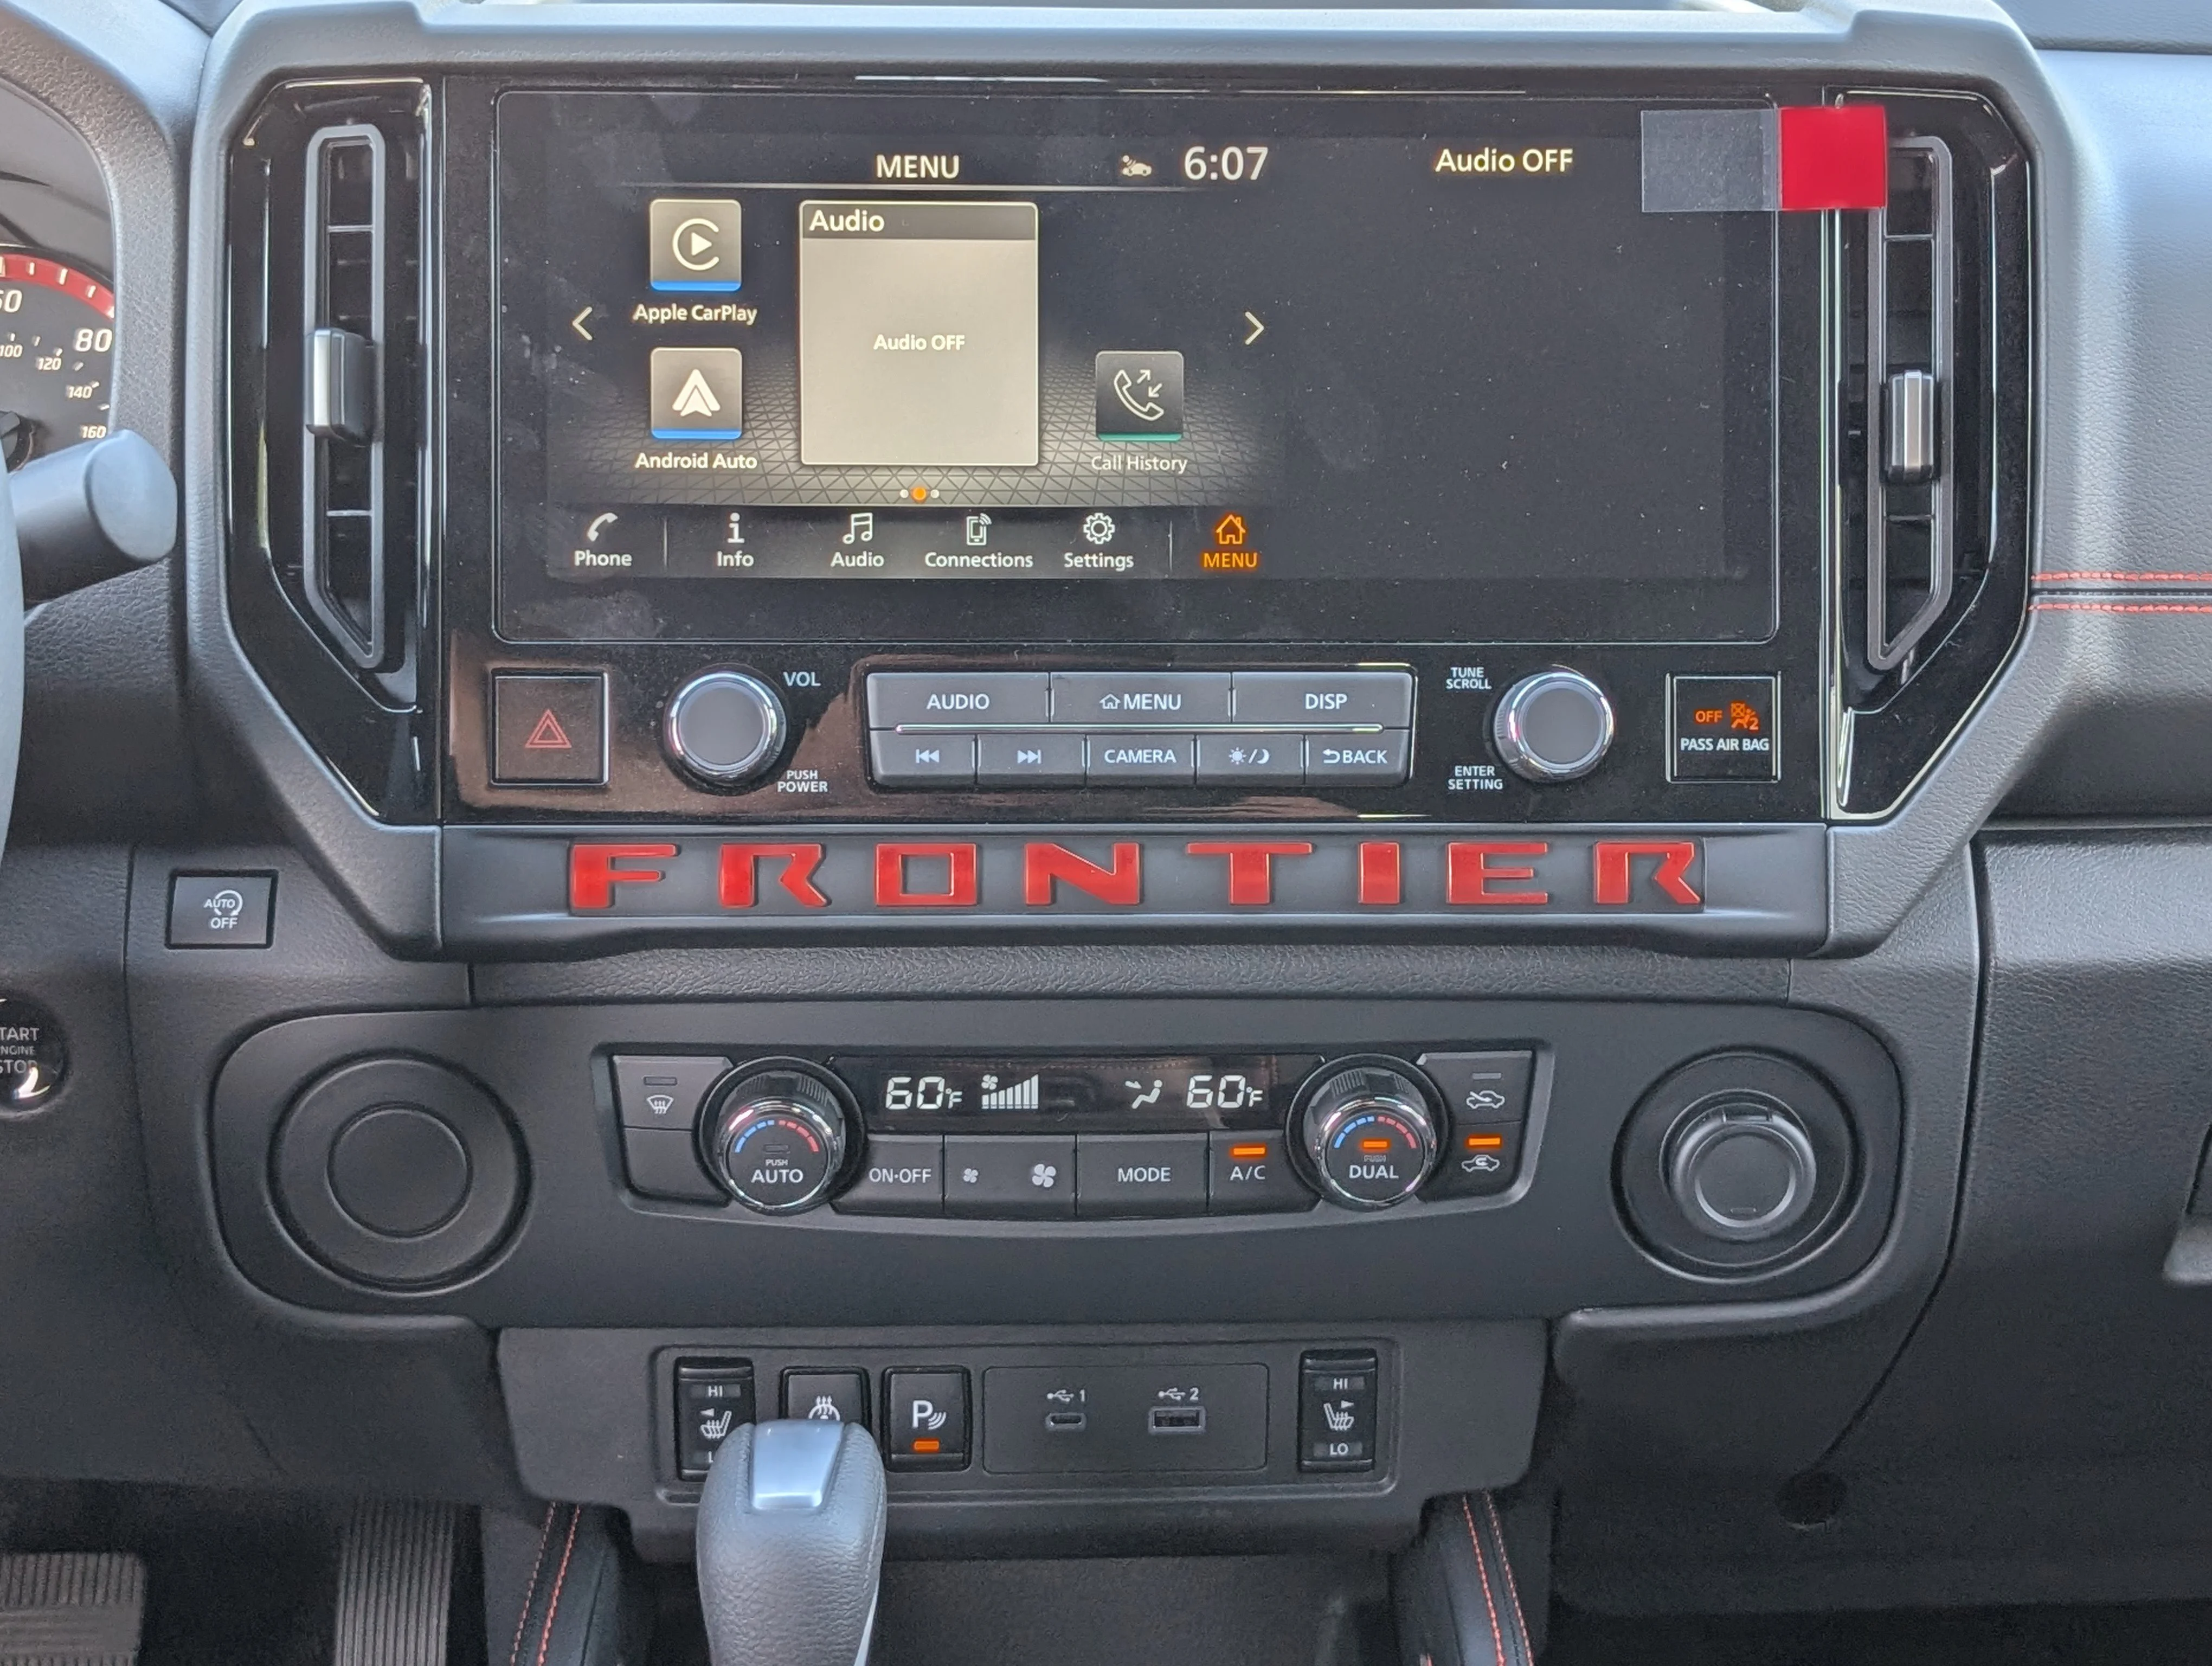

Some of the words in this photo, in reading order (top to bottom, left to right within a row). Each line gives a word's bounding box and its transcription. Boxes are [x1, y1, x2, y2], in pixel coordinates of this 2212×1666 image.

[876, 155, 960, 178] MENU
[1184, 146, 1269, 181] 6:07
[1435, 149, 1515, 172] Audio
[1521, 149, 1573, 172] OFF
[809, 209, 885, 232] Audio
[0, 290, 22, 312] 0
[633, 304, 687, 324] Apple
[691, 304, 757, 325] CarPlay
[74, 328, 112, 352] 80
[873, 334, 927, 351] Audio
[931, 335, 965, 351] OFF
[37, 357, 62, 370] 120
[68, 385, 92, 399] 140
[81, 425, 106, 439] 160
[635, 453, 708, 469] Android
[712, 453, 757, 469] Auto
[1091, 456, 1122, 471] Call
[1127, 456, 1187, 475] History
[574, 550, 632, 567] Phone
[717, 552, 754, 567] Info
[831, 552, 884, 568] Audio
[925, 552, 1033, 568] Connections
[1064, 553, 1134, 572] Settings
[1204, 553, 1257, 568] MENU
[783, 671, 821, 687] VOL
[1450, 667, 1484, 679] TUNE
[1446, 678, 1492, 690] SCROLL
[926, 694, 990, 710] AUDIO
[1124, 693, 1182, 710] MENU
[1306, 693, 1347, 709] DISP
[1695, 710, 1723, 723] OFF
[1680, 738, 1713, 751] PASS
[1716, 738, 1740, 751] AIR
[1742, 738, 1770, 751] BAG
[1104, 748, 1176, 764] CAMERA
[1343, 749, 1387, 764] BACK
[787, 770, 818, 780] PUSH
[1454, 766, 1495, 777] ENTER
[777, 781, 828, 792] POWER
[1448, 778, 1503, 790] SETTING
[569, 841, 1701, 909] FRONTIER
[203, 899, 235, 909] AUTO
[210, 917, 238, 930] OFF
[751, 1169, 803, 1184] AUTO
[1117, 1167, 1172, 1183] MODE
[1230, 1165, 1266, 1181] A/C
[1349, 1165, 1399, 1180] DUAL
[708, 1385, 723, 1398] HI
[1333, 1379, 1348, 1390] HI
[1079, 1389, 1085, 1402] 1
[1189, 1388, 1199, 1400] 2
[912, 1400, 933, 1428] P
[1329, 1443, 1348, 1456] LO
